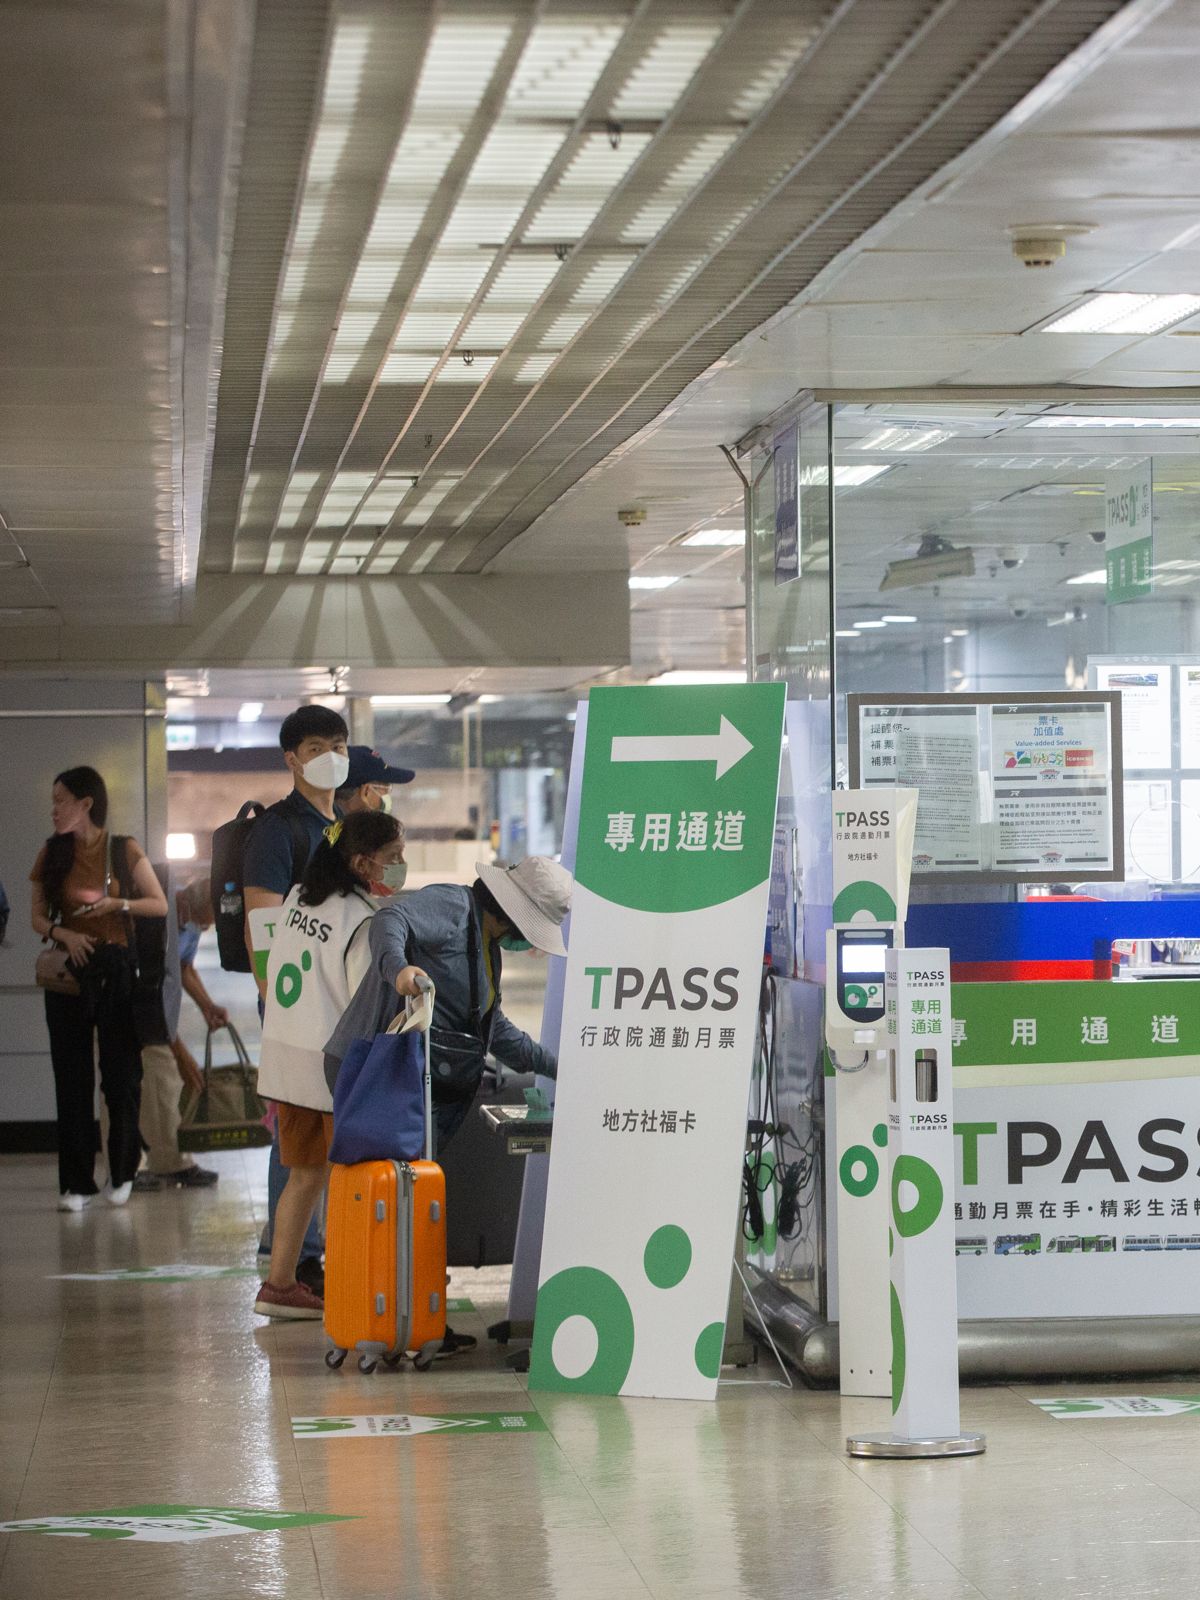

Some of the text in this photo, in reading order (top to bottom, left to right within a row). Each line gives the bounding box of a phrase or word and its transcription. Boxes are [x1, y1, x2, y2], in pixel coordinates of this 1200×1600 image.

[870, 755, 897, 767] 補票
[834, 810, 890, 828] TPASS
[603, 811, 747, 854] 專用通道
[284, 907, 333, 944] TPASS
[906, 970, 945, 980] TPASS
[583, 966, 740, 1012] TPASS
[911, 999, 941, 1015] 專用
[911, 1018, 943, 1035] 通道
[580, 1025, 737, 1049] 行政院通勤月票
[602, 1109, 697, 1135] 地方社福卡
[908, 1114, 948, 1124] TPASS
